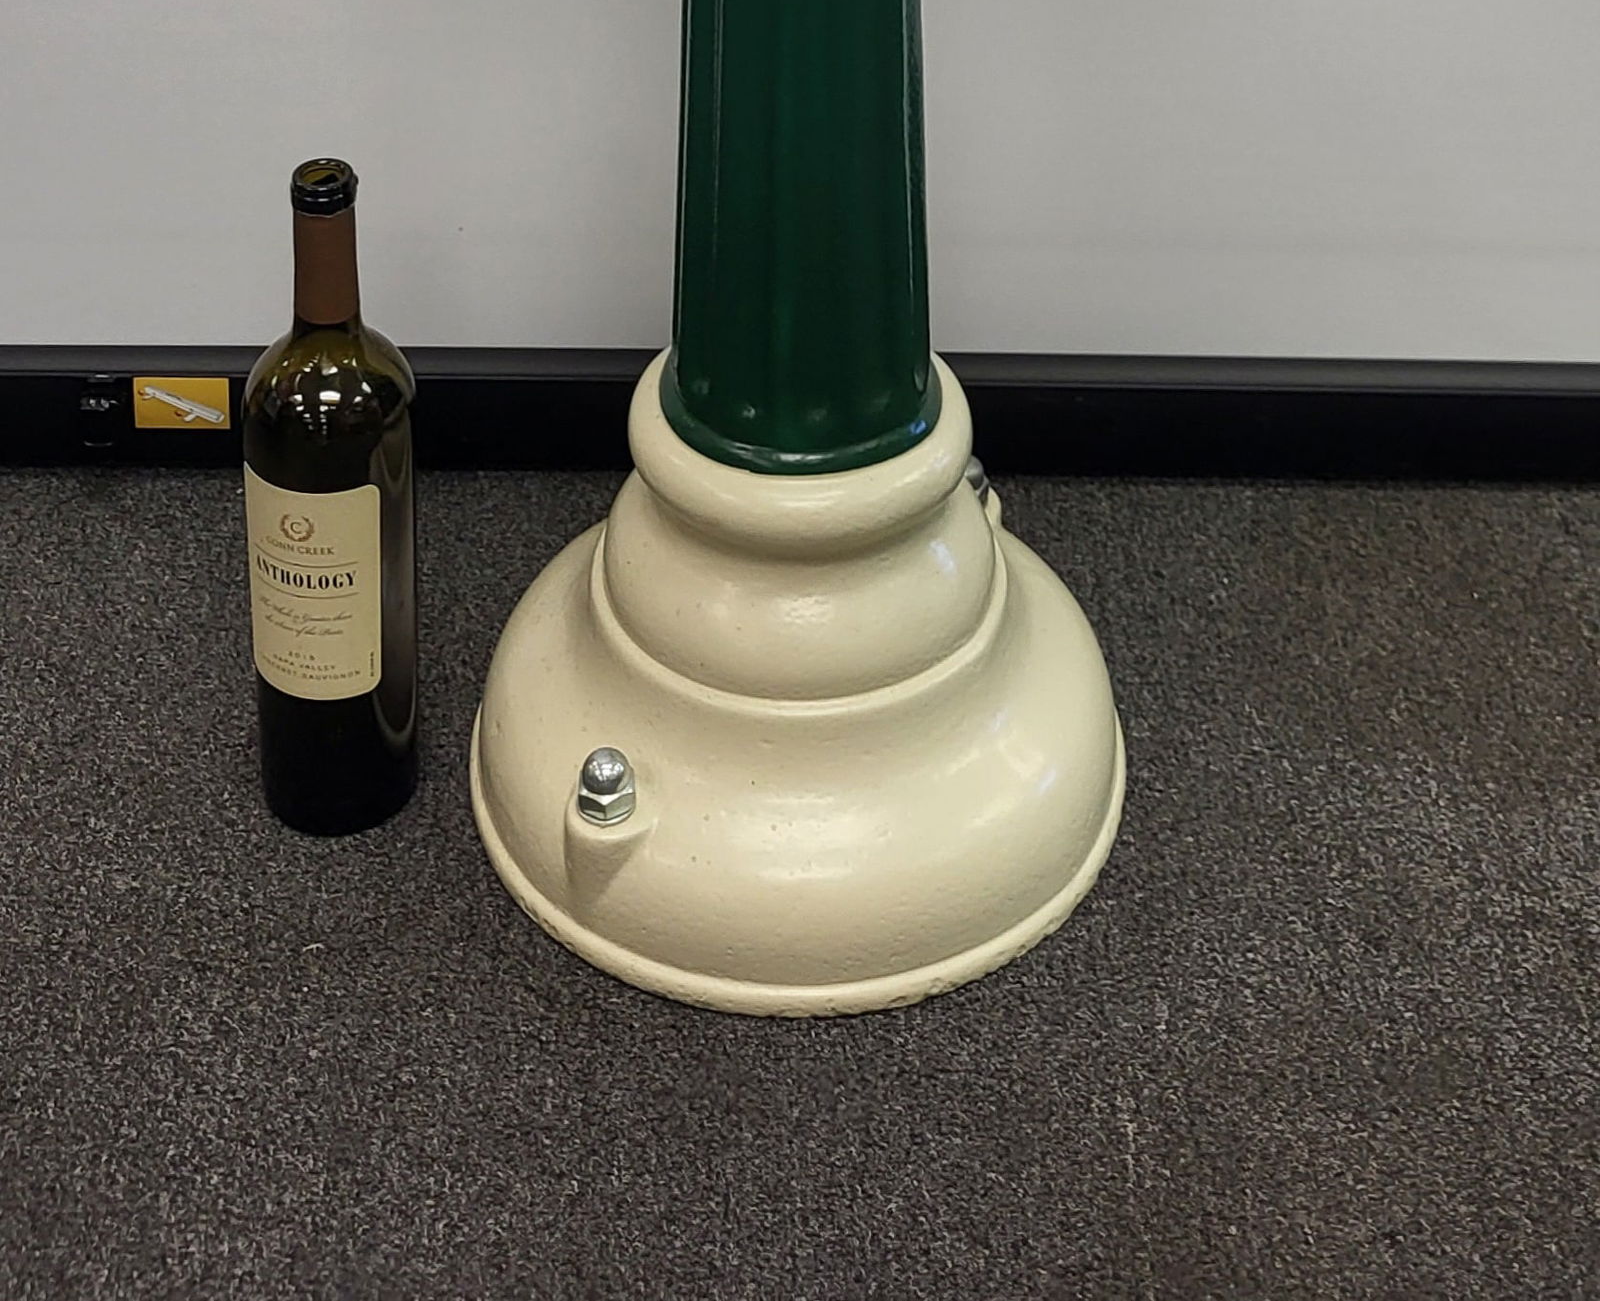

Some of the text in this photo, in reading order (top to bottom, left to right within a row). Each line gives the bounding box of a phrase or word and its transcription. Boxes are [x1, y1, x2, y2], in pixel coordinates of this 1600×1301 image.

[297, 545, 335, 556] CREEK
[256, 554, 357, 590] ANTHOLOGY
[299, 663, 336, 672] VALLEY
